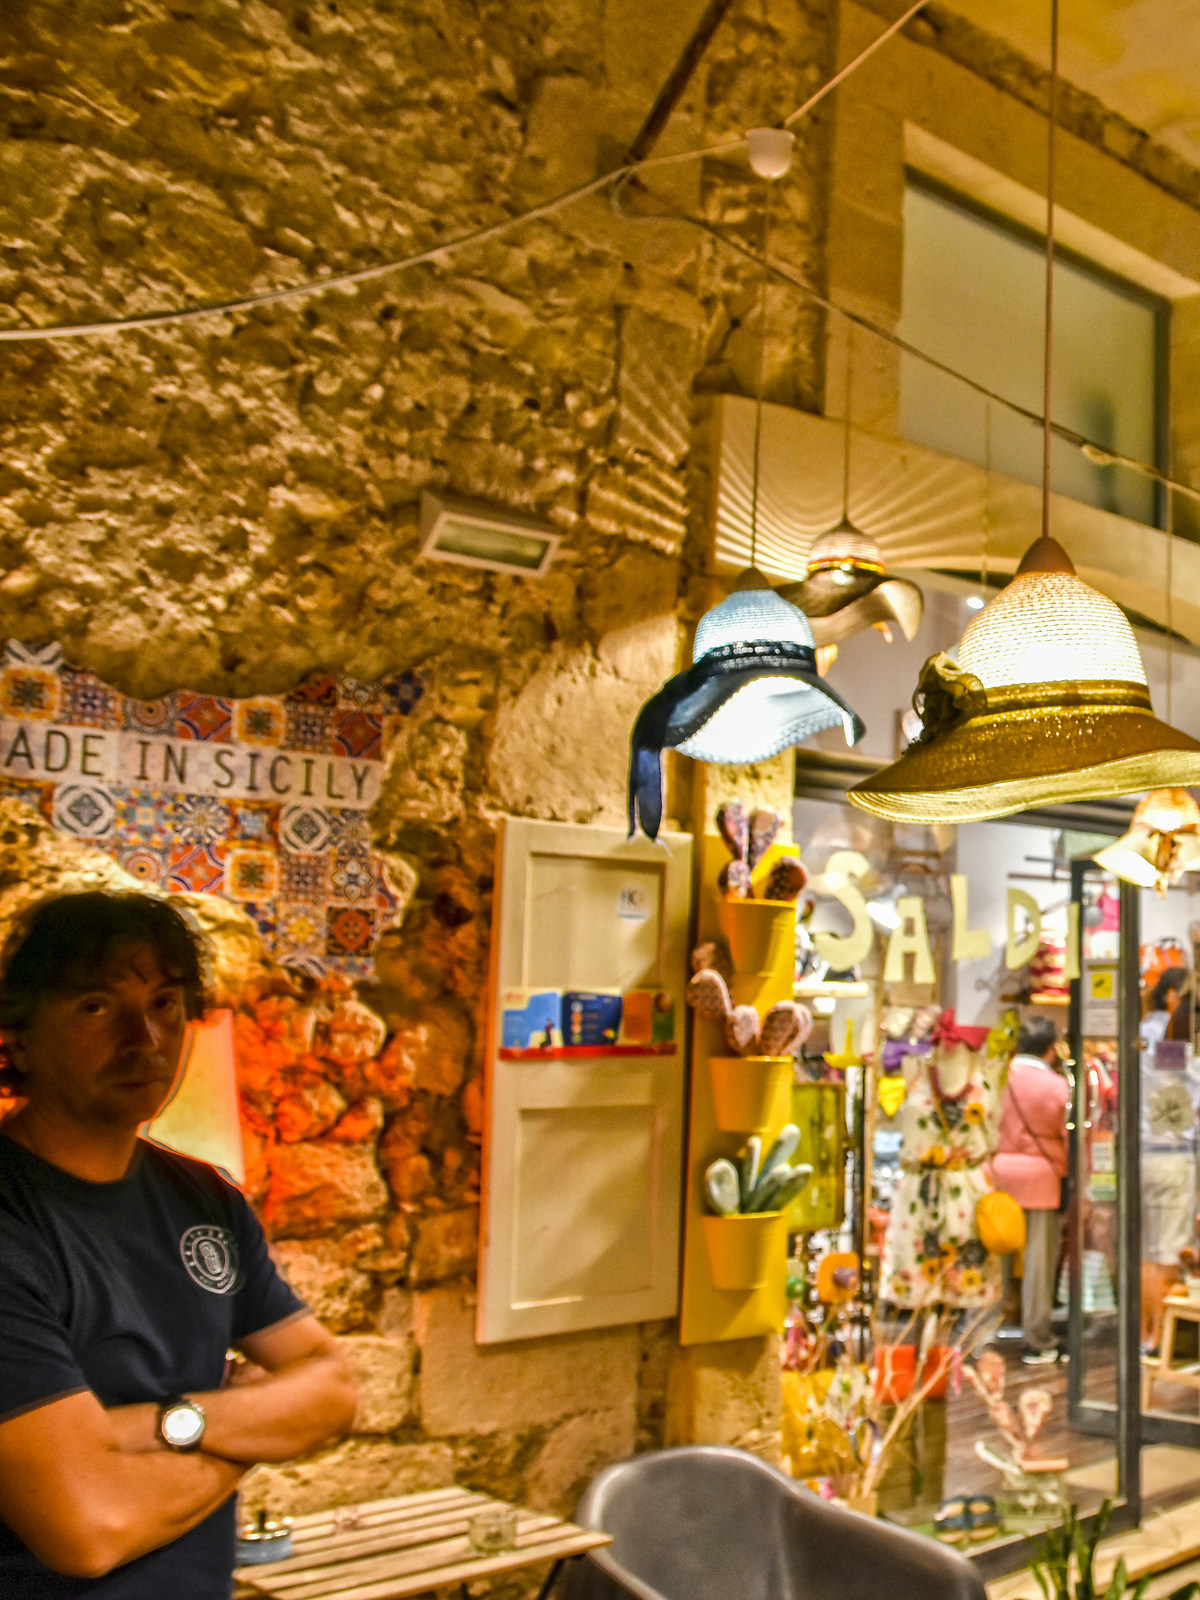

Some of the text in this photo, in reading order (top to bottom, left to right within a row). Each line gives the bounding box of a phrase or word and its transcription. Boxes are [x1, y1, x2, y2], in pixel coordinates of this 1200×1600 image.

[3, 726, 371, 801] ADE IN SICILY
[812, 850, 1081, 984] SALDI
